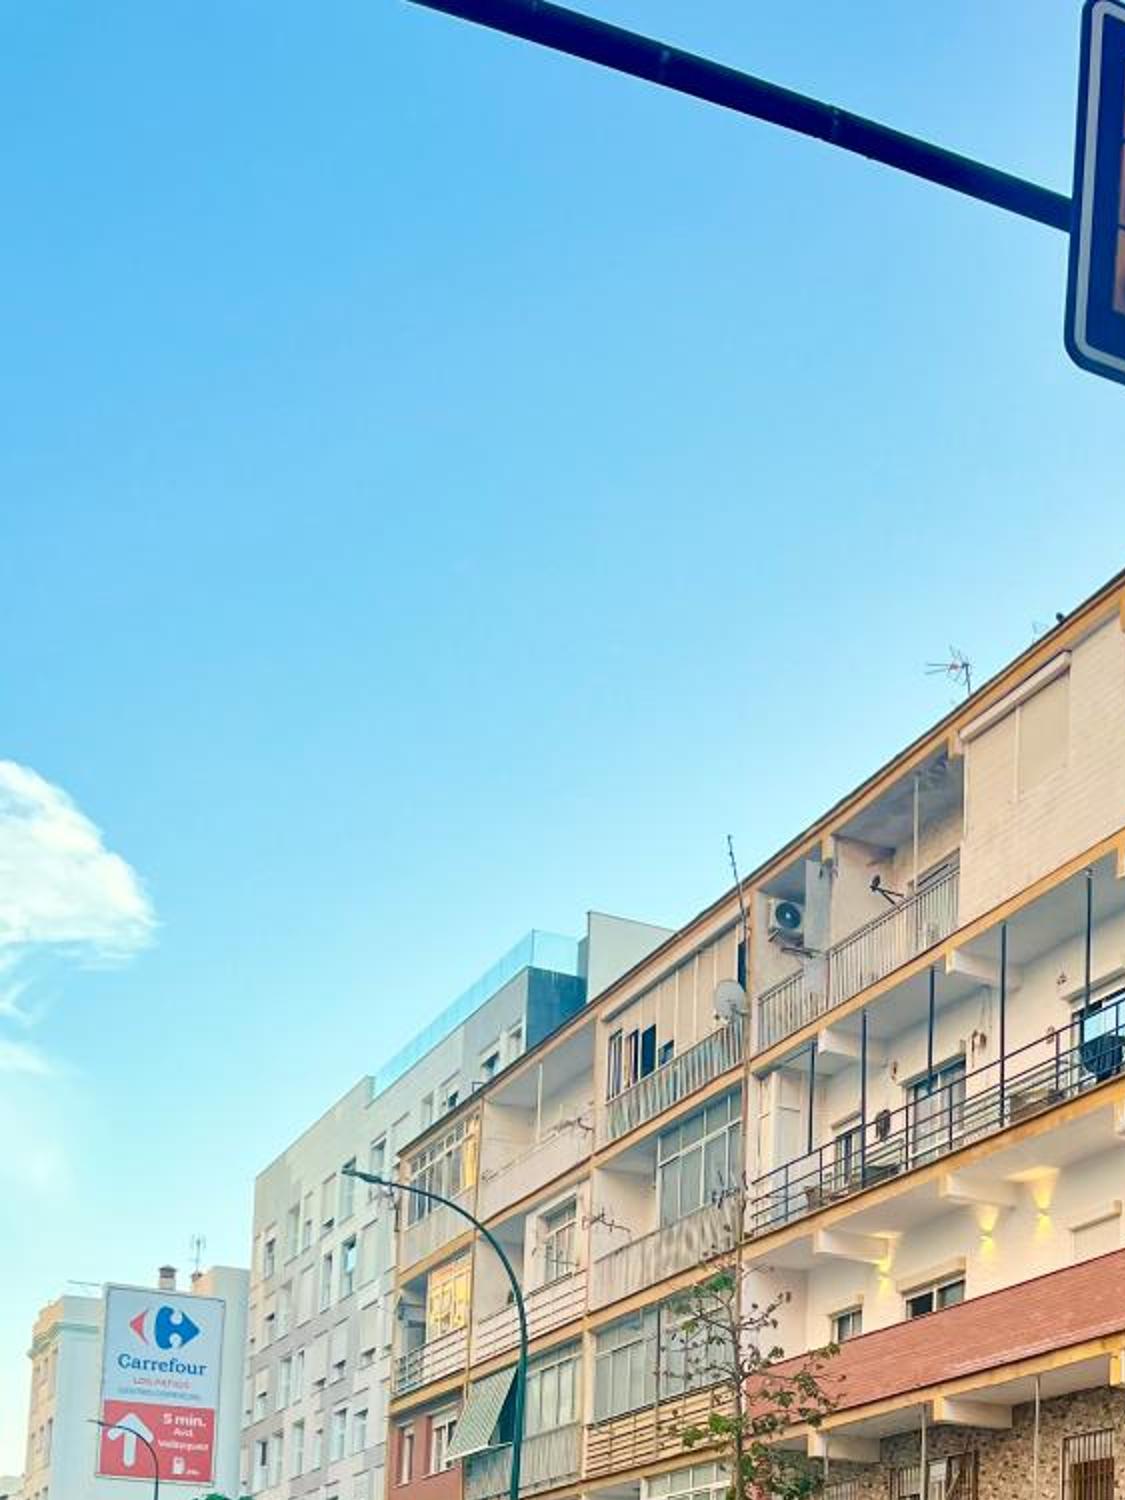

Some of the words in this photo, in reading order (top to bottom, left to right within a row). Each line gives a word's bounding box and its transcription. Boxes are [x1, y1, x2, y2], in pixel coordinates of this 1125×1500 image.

[118, 1353, 208, 1376] Carrefour
[163, 1413, 173, 1424] 5
[175, 1414, 206, 1427] min.
